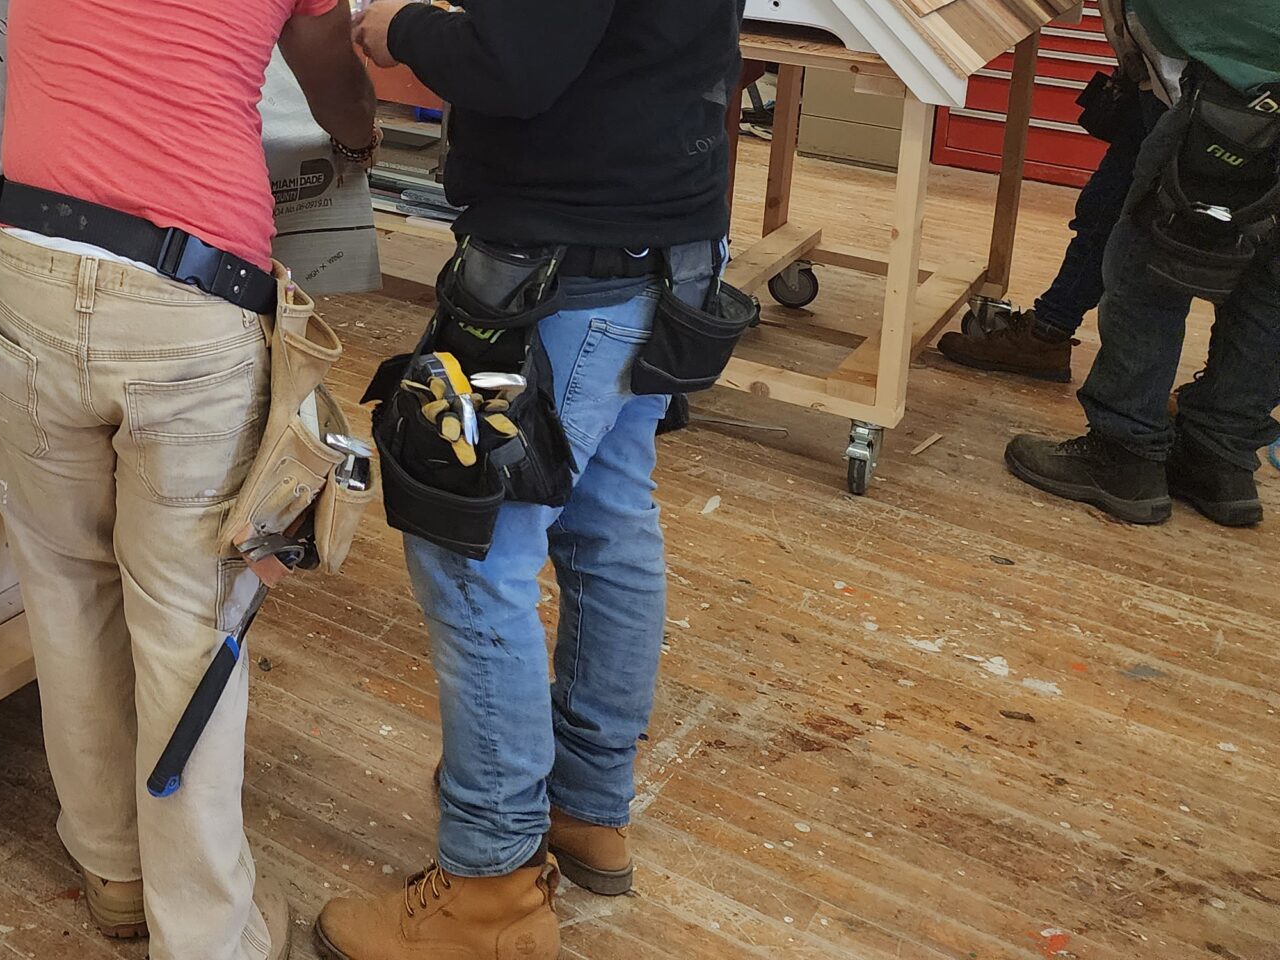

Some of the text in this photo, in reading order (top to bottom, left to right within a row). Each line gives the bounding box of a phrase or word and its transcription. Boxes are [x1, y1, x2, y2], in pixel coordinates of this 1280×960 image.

[271, 174, 324, 190] MIAMI DADE
[305, 268, 320, 281] HIGH
[327, 251, 344, 264] WIND
